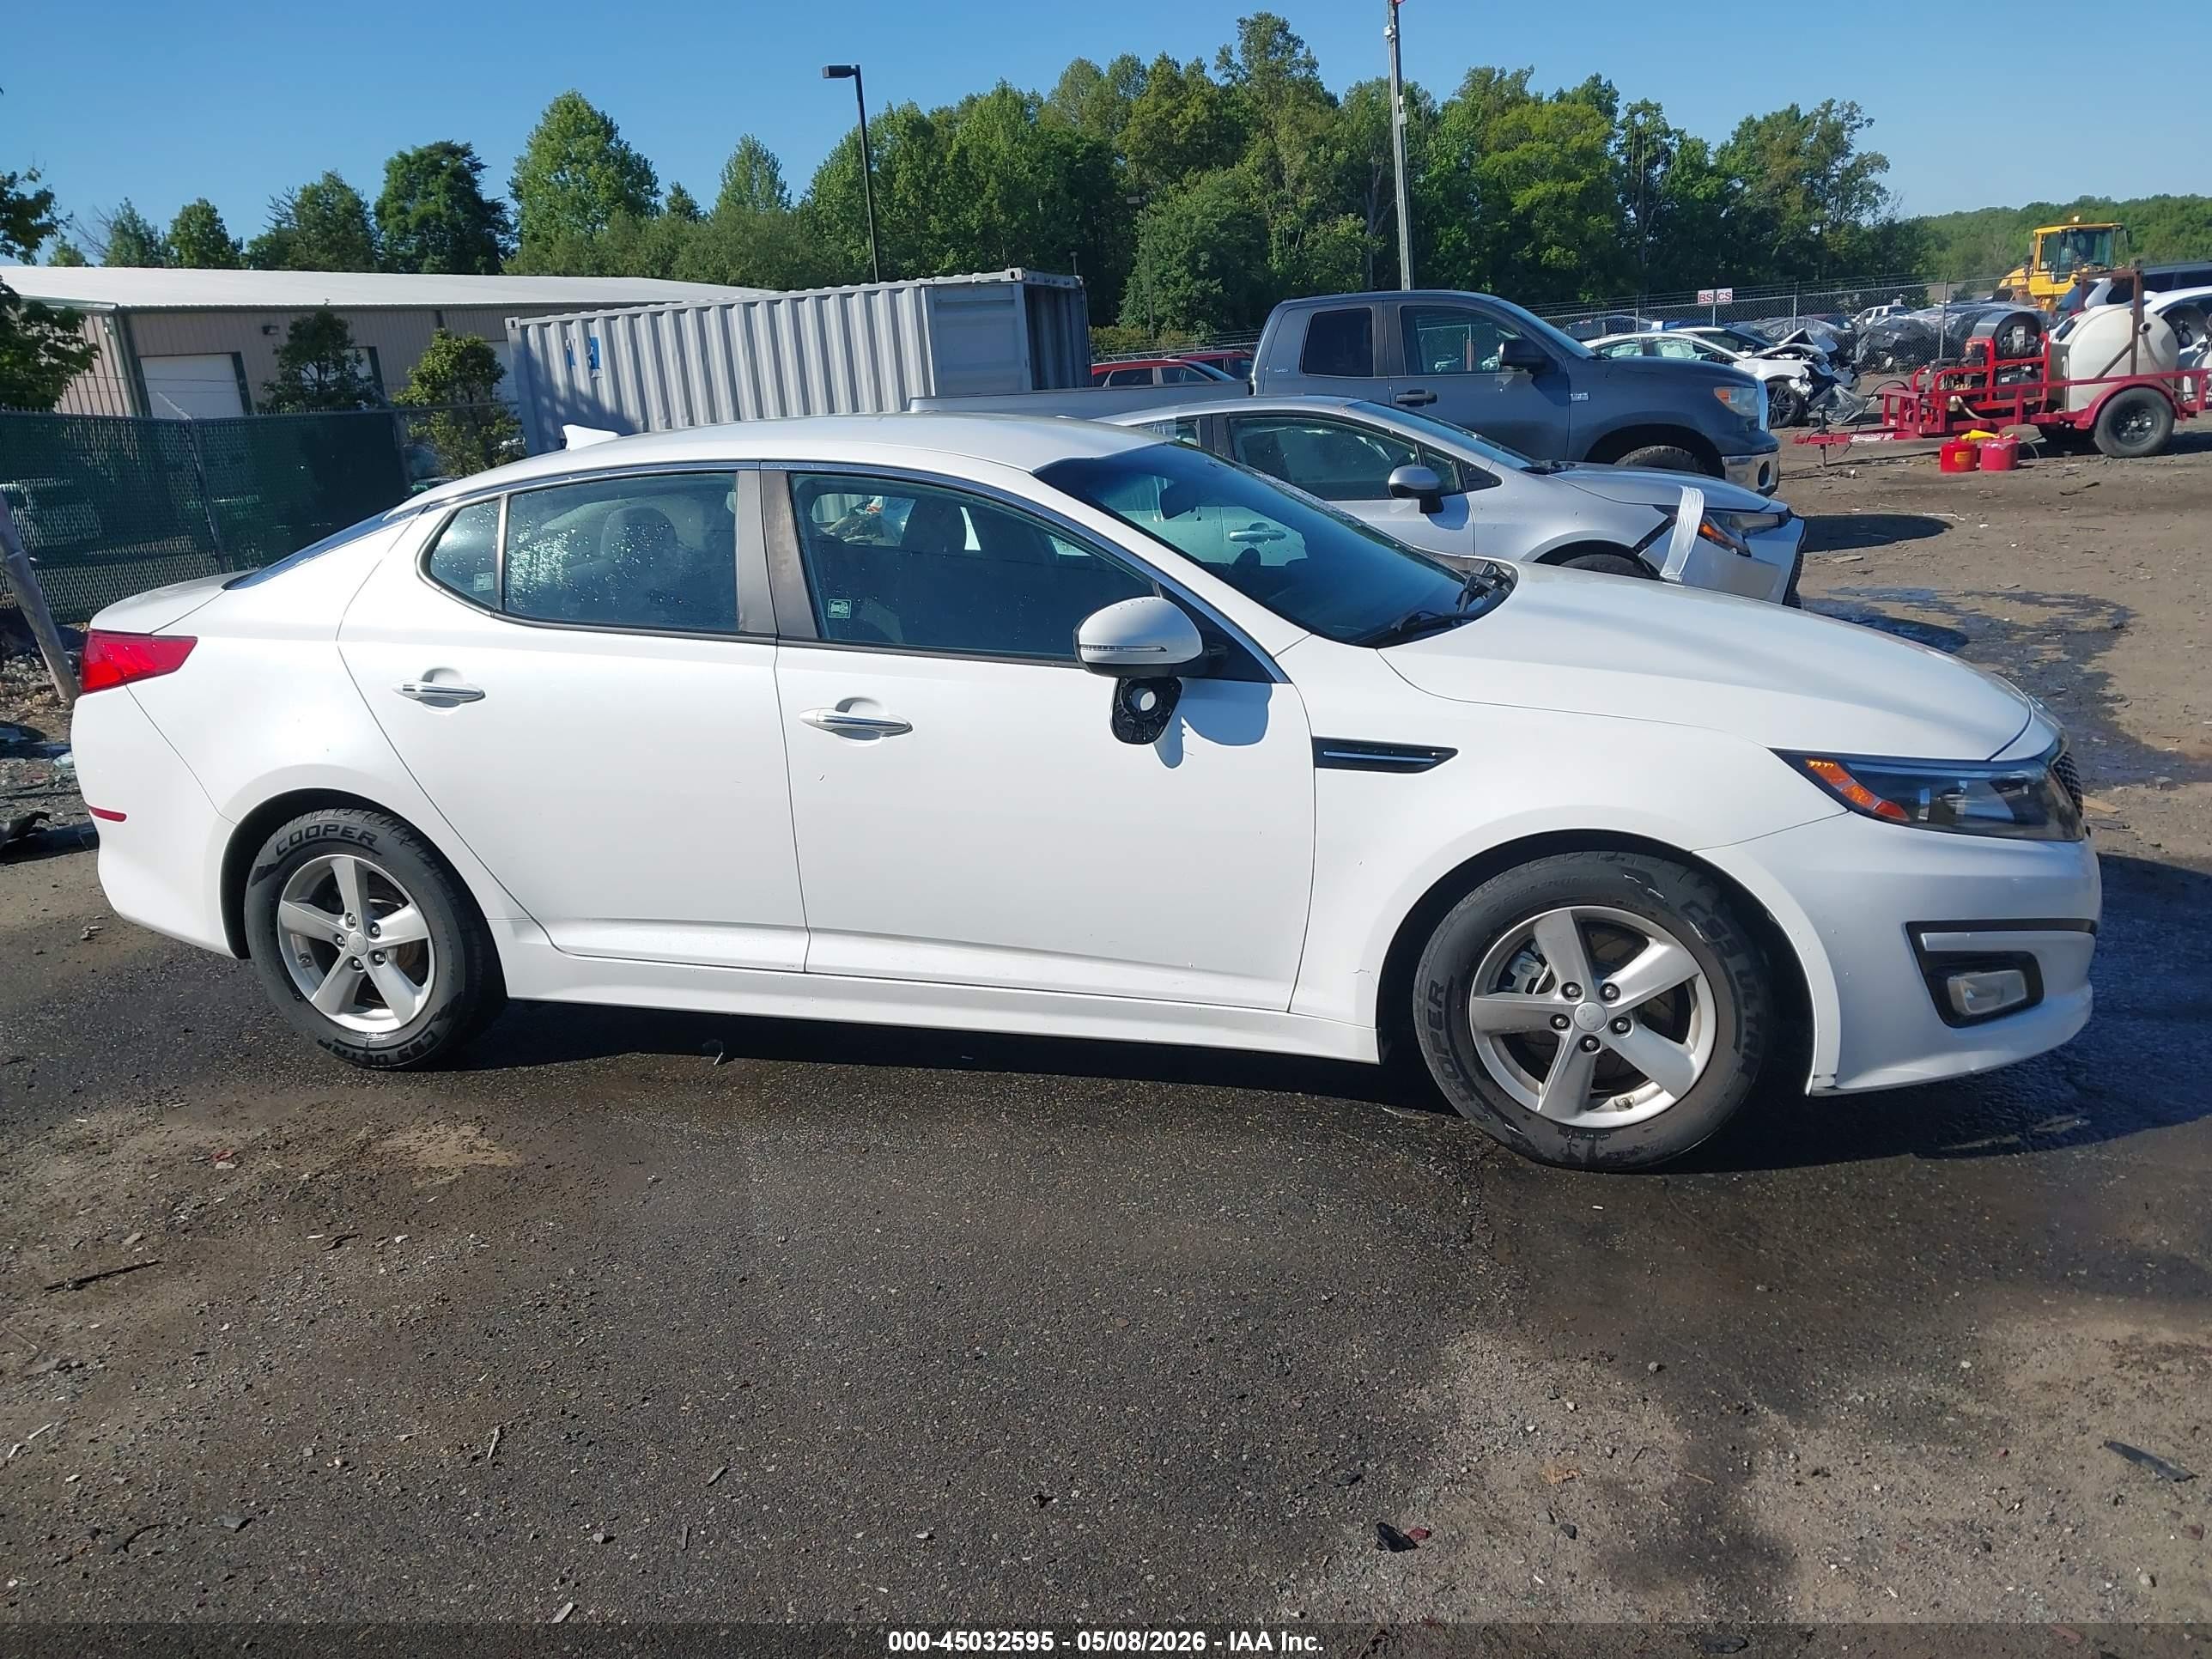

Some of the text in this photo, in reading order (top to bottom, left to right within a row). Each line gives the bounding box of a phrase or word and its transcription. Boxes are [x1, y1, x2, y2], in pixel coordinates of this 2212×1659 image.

[1698, 293, 1713, 302] BS
[1717, 292, 1732, 301] CS
[276, 823, 378, 857] COOPER
